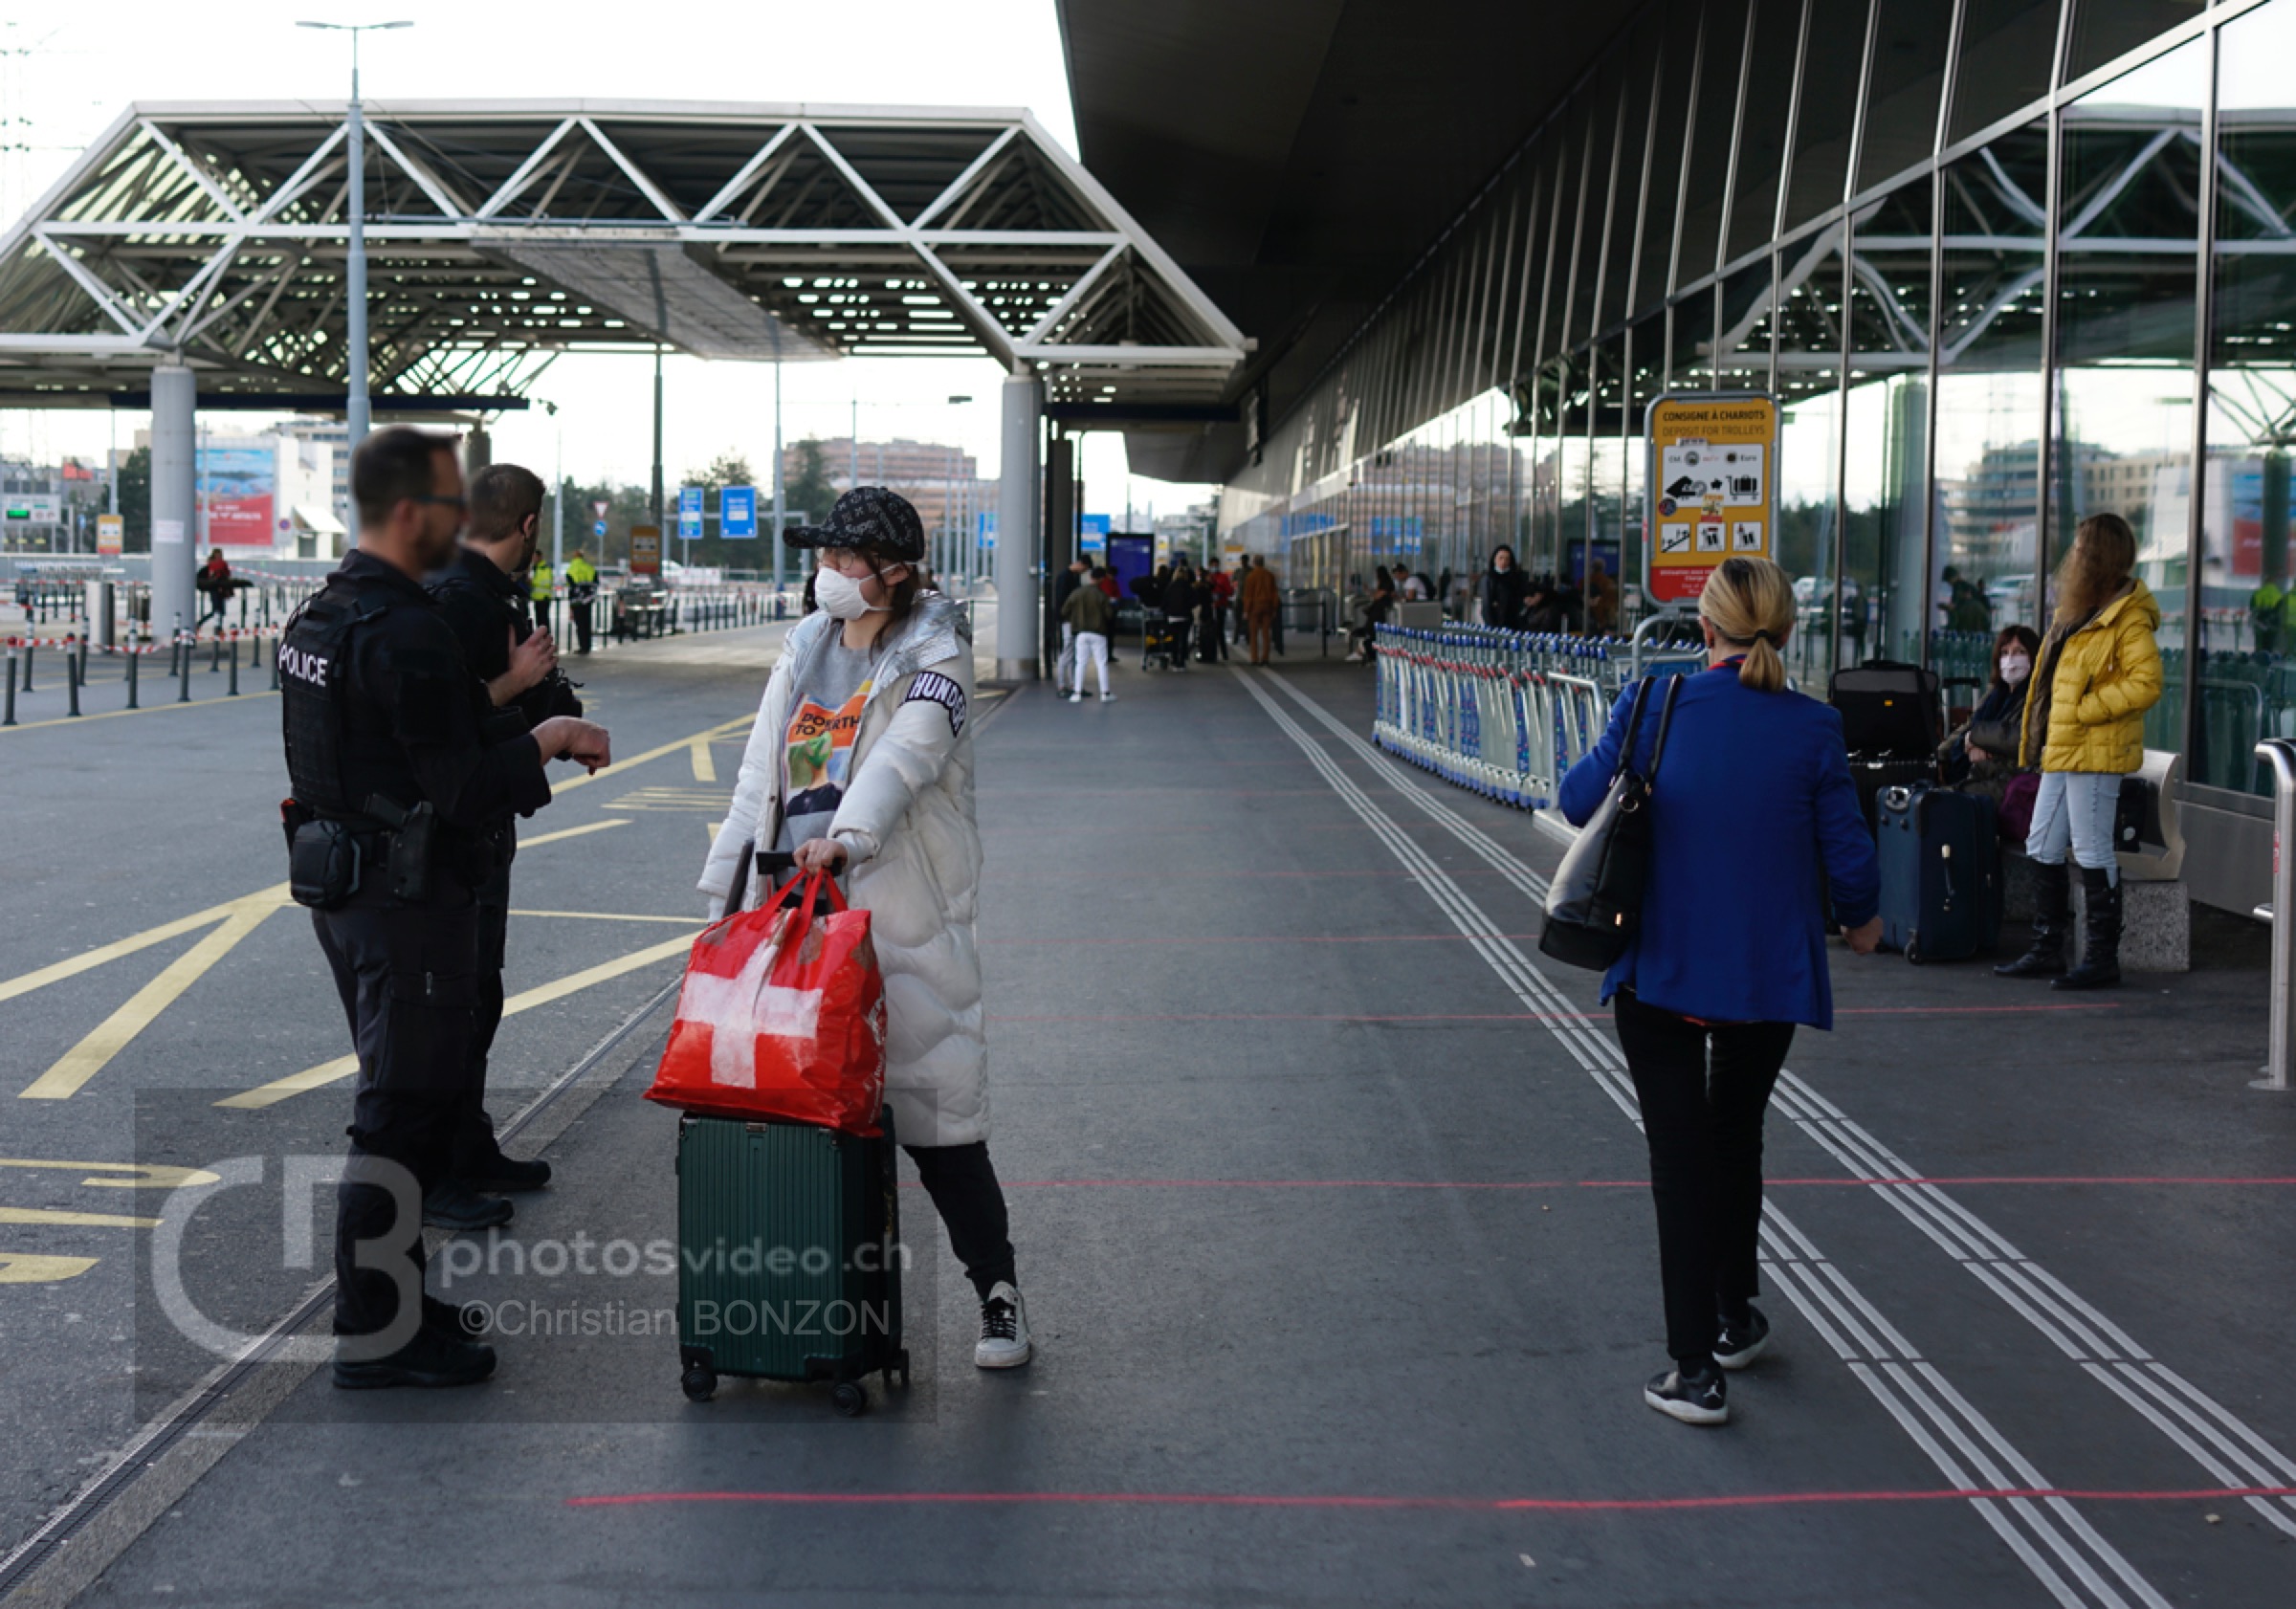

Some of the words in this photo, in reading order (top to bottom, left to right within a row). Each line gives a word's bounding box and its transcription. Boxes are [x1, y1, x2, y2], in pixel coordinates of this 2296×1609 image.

[1663, 410, 1710, 422] CONSIGNE
[1720, 408, 1766, 420] CHARIOTS
[1663, 427, 1700, 437] DEPOSIT
[1702, 426, 1720, 436] FOR
[1721, 425, 1765, 435] TROLLEYS
[278, 644, 328, 688] POLICE
